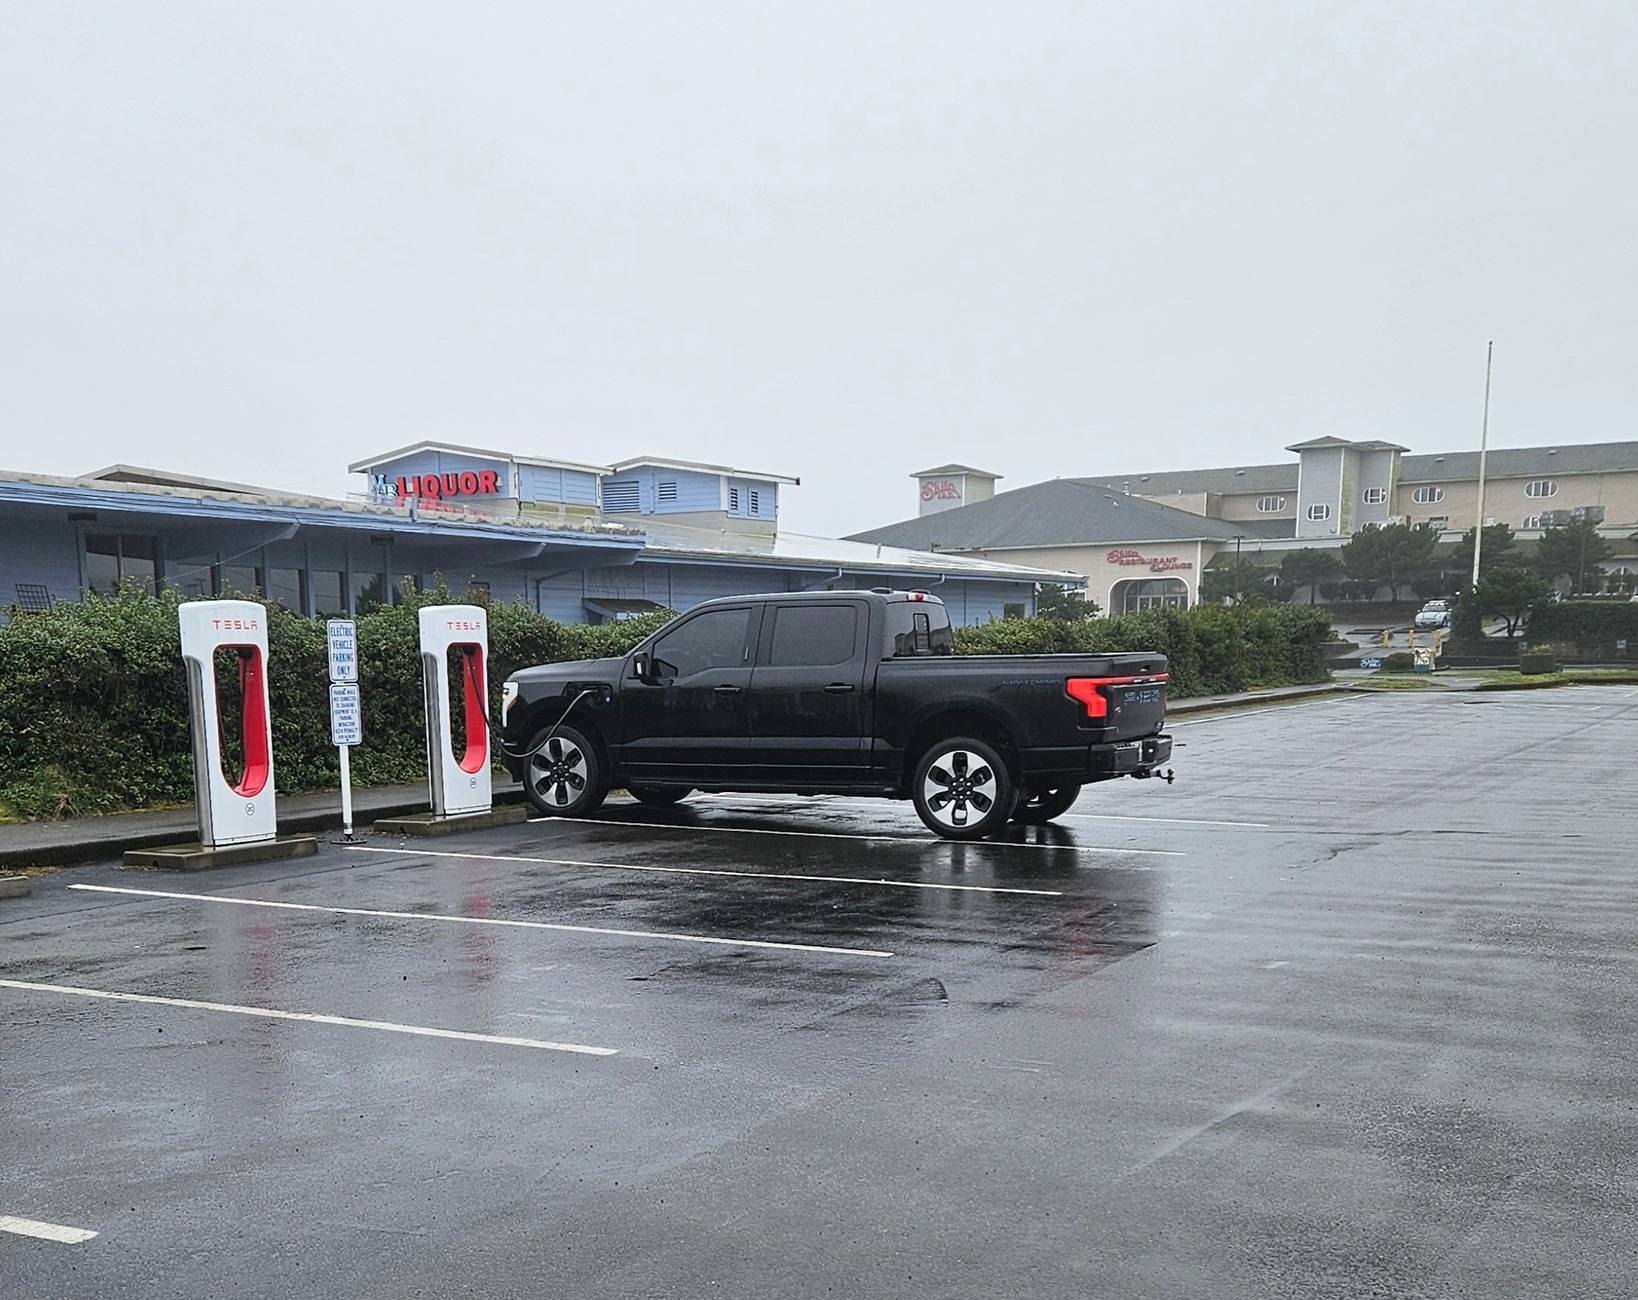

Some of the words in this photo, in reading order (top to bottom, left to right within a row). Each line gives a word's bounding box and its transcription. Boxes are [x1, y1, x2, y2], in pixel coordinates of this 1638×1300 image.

[396, 469, 498, 500] LIQUOR
[1119, 557, 1178, 566] RESTAURANT
[212, 620, 257, 630] TESLA
[447, 621, 481, 630] TESLA
[330, 626, 353, 637] ELECTRIC
[332, 640, 353, 650] VEHICLE
[332, 652, 354, 662] PARKING
[337, 665, 350, 675] ONLY
